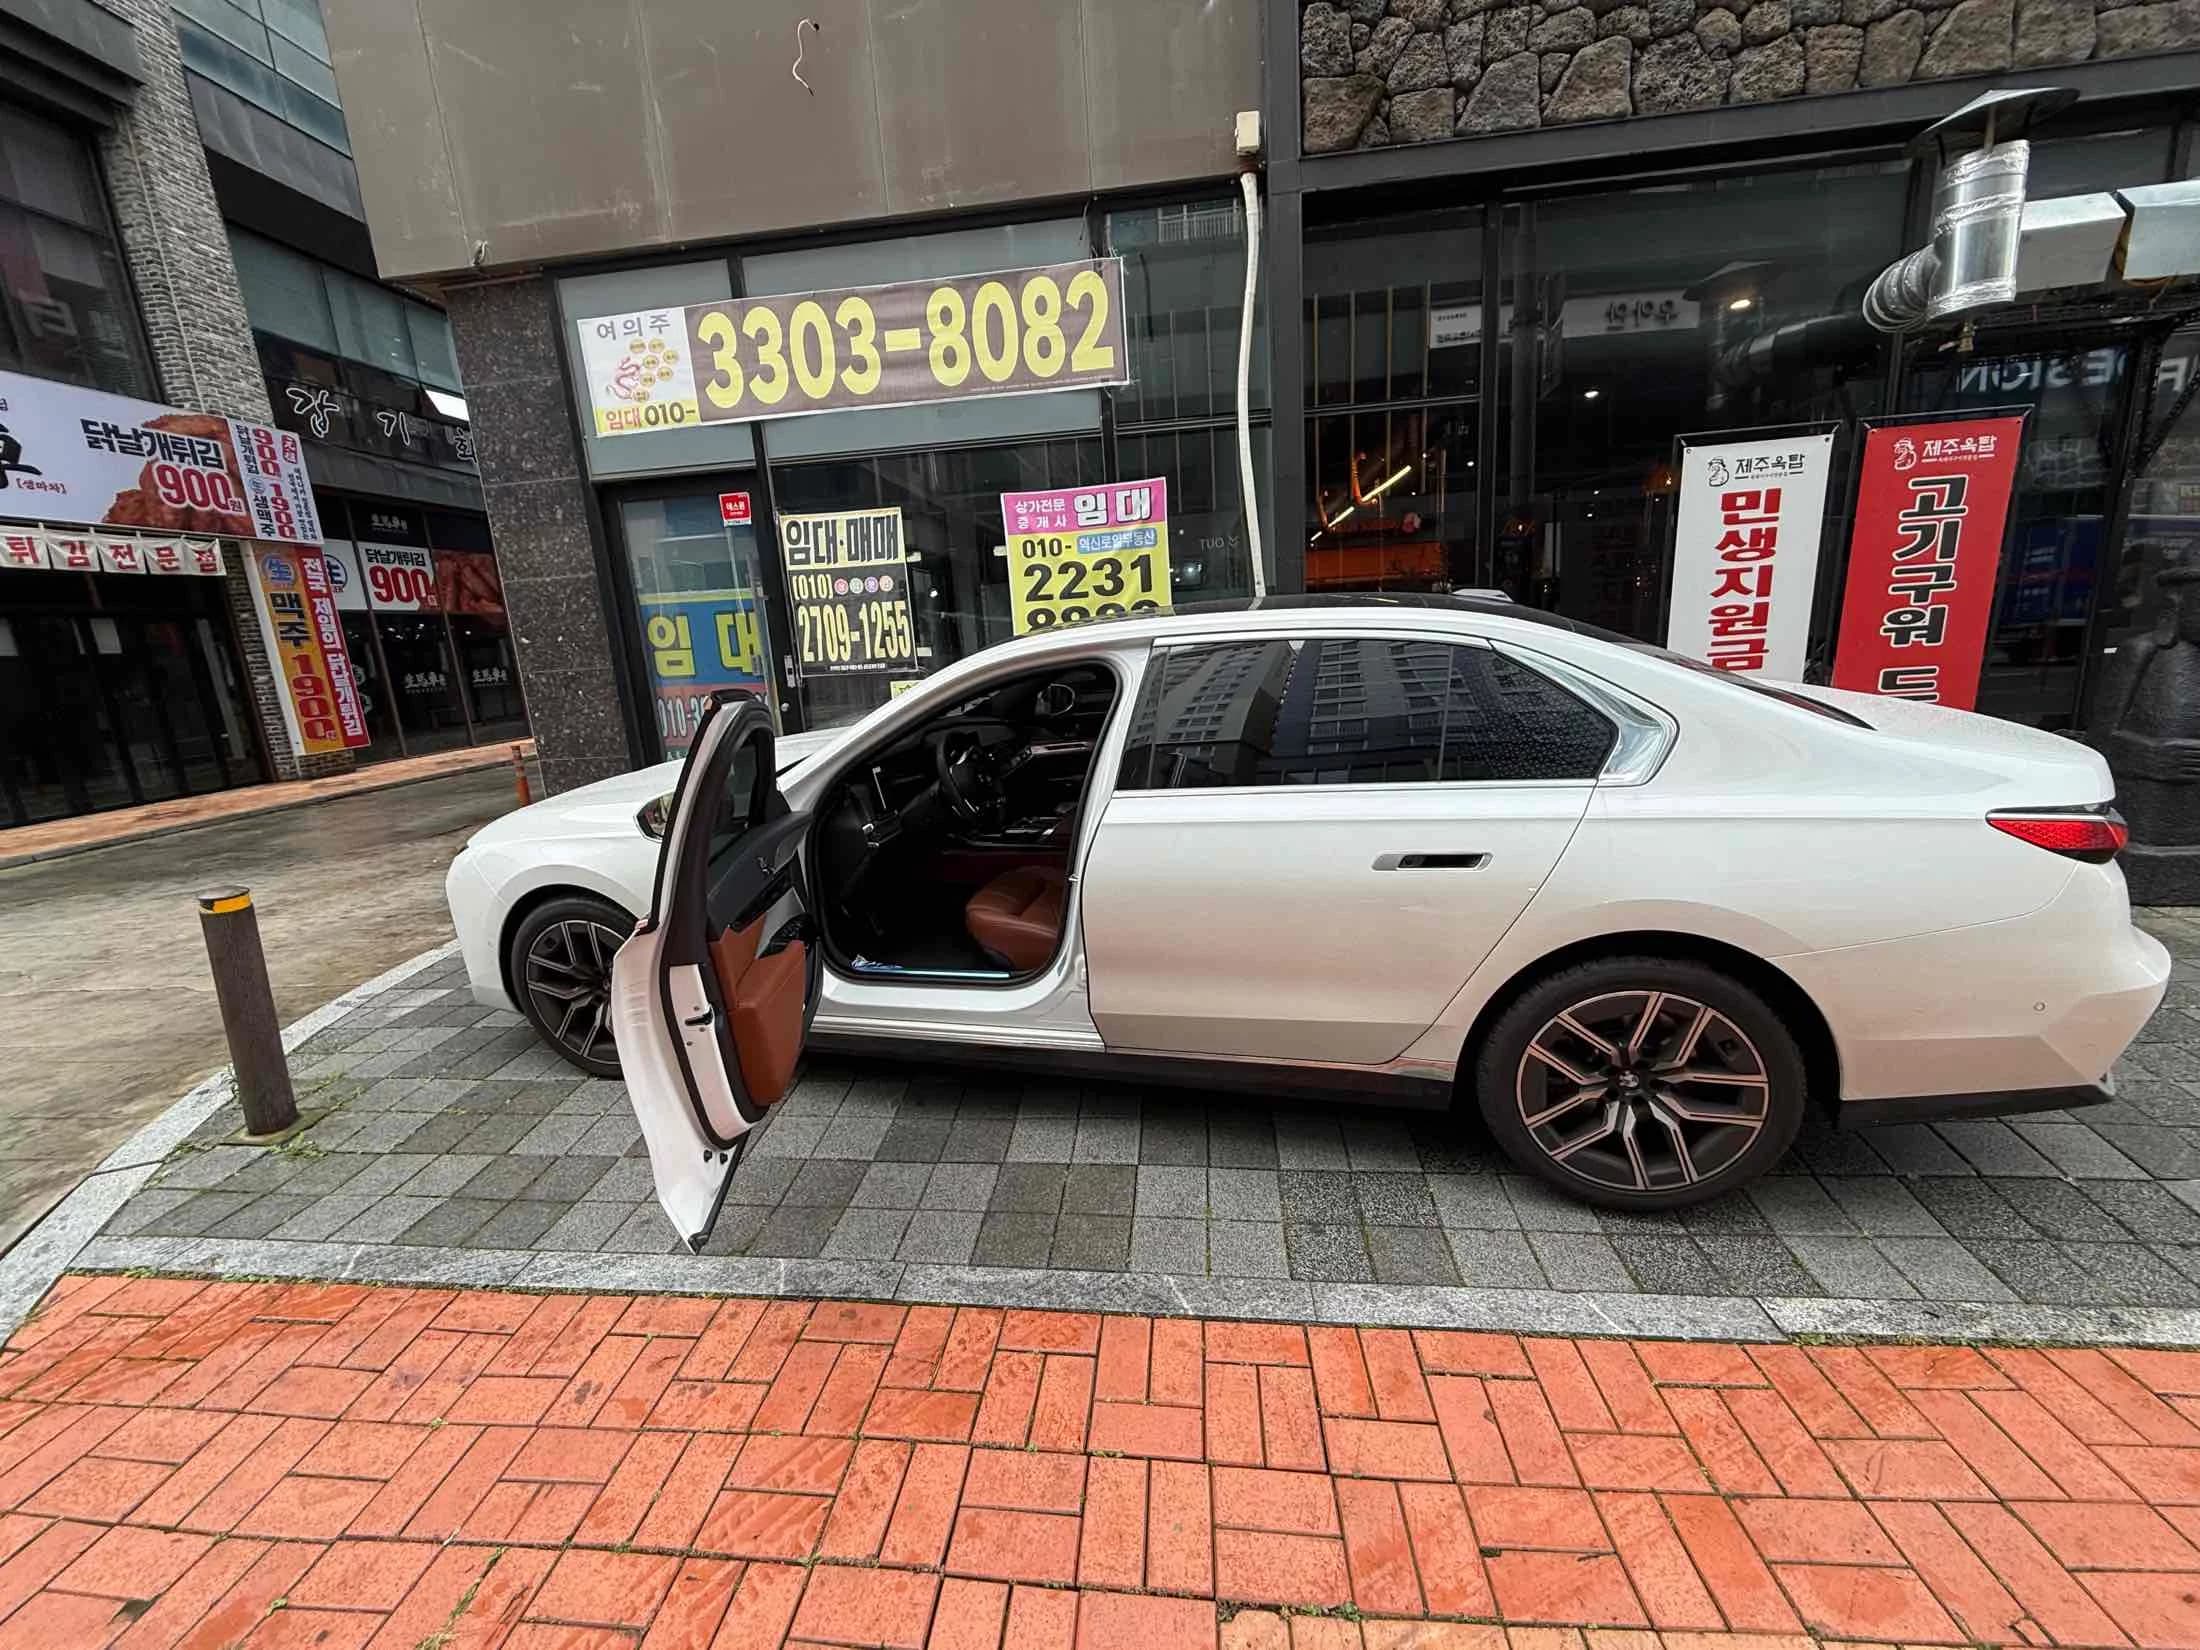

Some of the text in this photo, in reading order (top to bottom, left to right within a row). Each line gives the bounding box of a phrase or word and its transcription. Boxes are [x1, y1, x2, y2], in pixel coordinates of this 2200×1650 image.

[698, 270, 1115, 409] 3303-8082
[605, 401, 697, 431] 임대 010-
[79, 418, 226, 470] 닭날개튀김
[1735, 454, 1805, 474] 제주옥탑
[1015, 498, 1066, 514] 상가전문
[1074, 488, 1152, 528] 임대
[5, 536, 218, 573] 튀김전문점
[1023, 553, 1153, 602] 2231
[1707, 487, 1782, 672] 민생지원금
[1879, 474, 1968, 647] 고기구워
[269, 592, 313, 647] 맥주
[797, 600, 912, 662] 2709-1255
